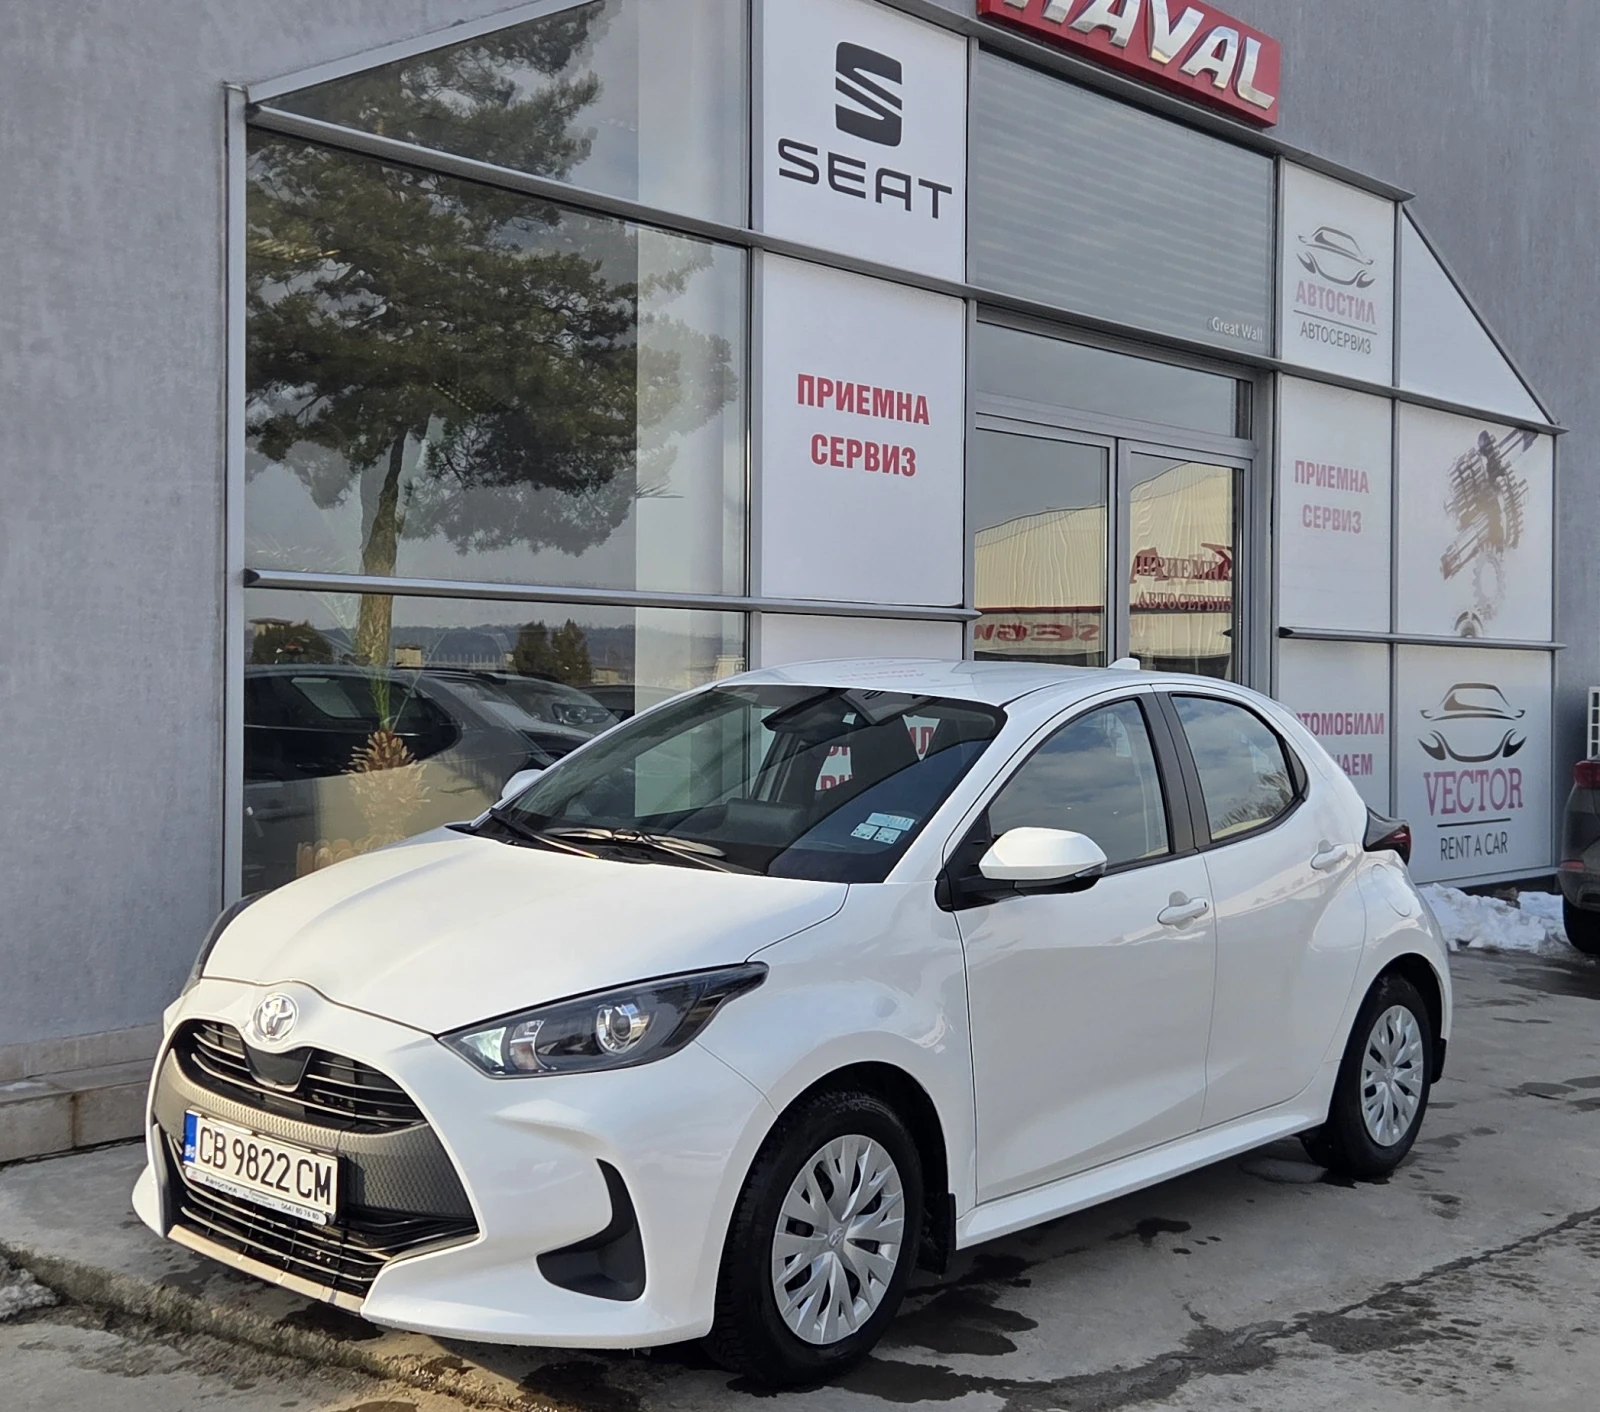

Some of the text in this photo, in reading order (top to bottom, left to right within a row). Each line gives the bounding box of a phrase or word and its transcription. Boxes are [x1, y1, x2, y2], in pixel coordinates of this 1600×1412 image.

[1003, 0, 1275, 109] AVAL
[778, 138, 952, 219] SEAT
[1295, 280, 1376, 325] АВТОСТИЛ
[1212, 316, 1263, 341] Great Wall
[1300, 321, 1372, 355] АВТОСЕРВИЗ
[797, 373, 930, 425] ПРИЕМНА
[811, 433, 917, 477] СЕРВИЗ
[1294, 460, 1370, 494] ПРИЕМНА
[1302, 504, 1362, 534] СЕРВИЗ
[1297, 712, 1384, 736] ТОМОБИЛИ
[1335, 753, 1373, 776] АЕМ
[1423, 767, 1523, 816] VECTOR
[1440, 831, 1508, 861] RENT A CAR
[200, 1126, 227, 1169] CB
[232, 1138, 290, 1193] 9822
[296, 1158, 332, 1205] CM
